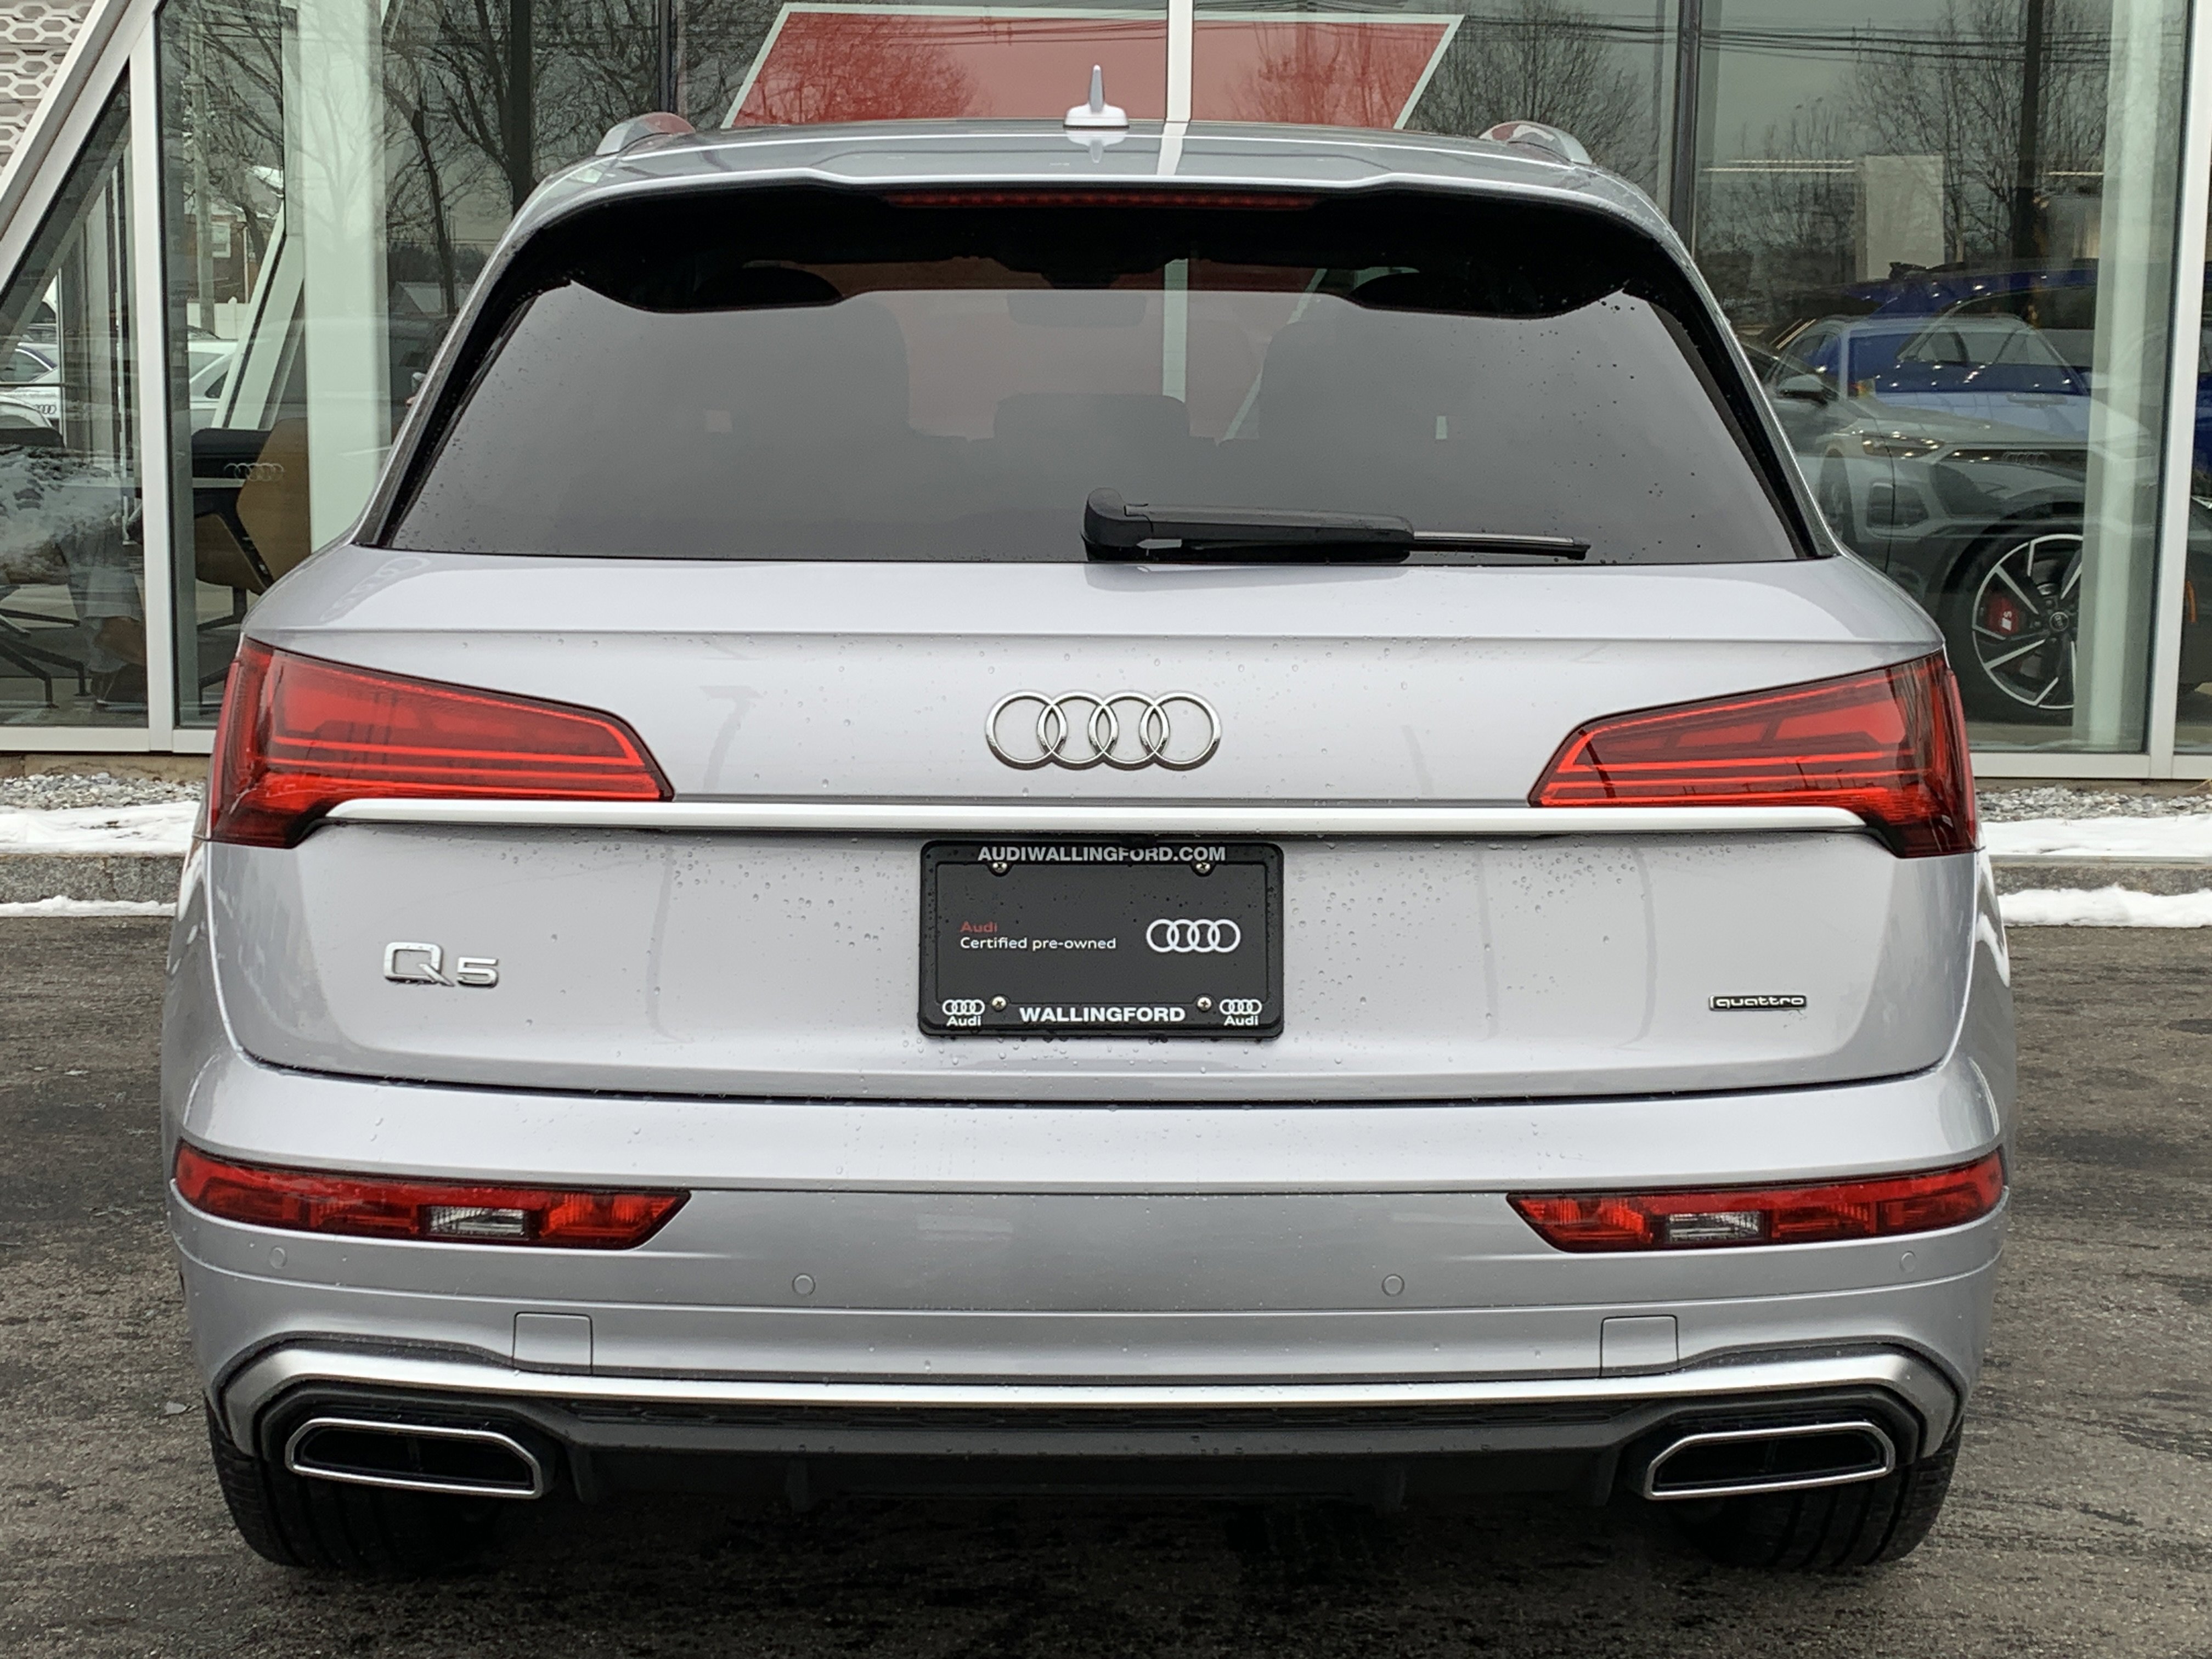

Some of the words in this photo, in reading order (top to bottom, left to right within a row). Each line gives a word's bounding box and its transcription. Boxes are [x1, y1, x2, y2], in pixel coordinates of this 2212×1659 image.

[977, 846, 1226, 861] AUDIWALLINGFORD.COM
[960, 921, 998, 933] Audi
[960, 937, 1028, 949] Certified
[1032, 938, 1117, 952] pre-owned
[383, 941, 498, 988] Q5
[1716, 996, 1805, 1009] quattro
[946, 1015, 981, 1026] Audi
[1019, 1007, 1186, 1022] WALLINGFORD
[1224, 1015, 1259, 1026] Audi
